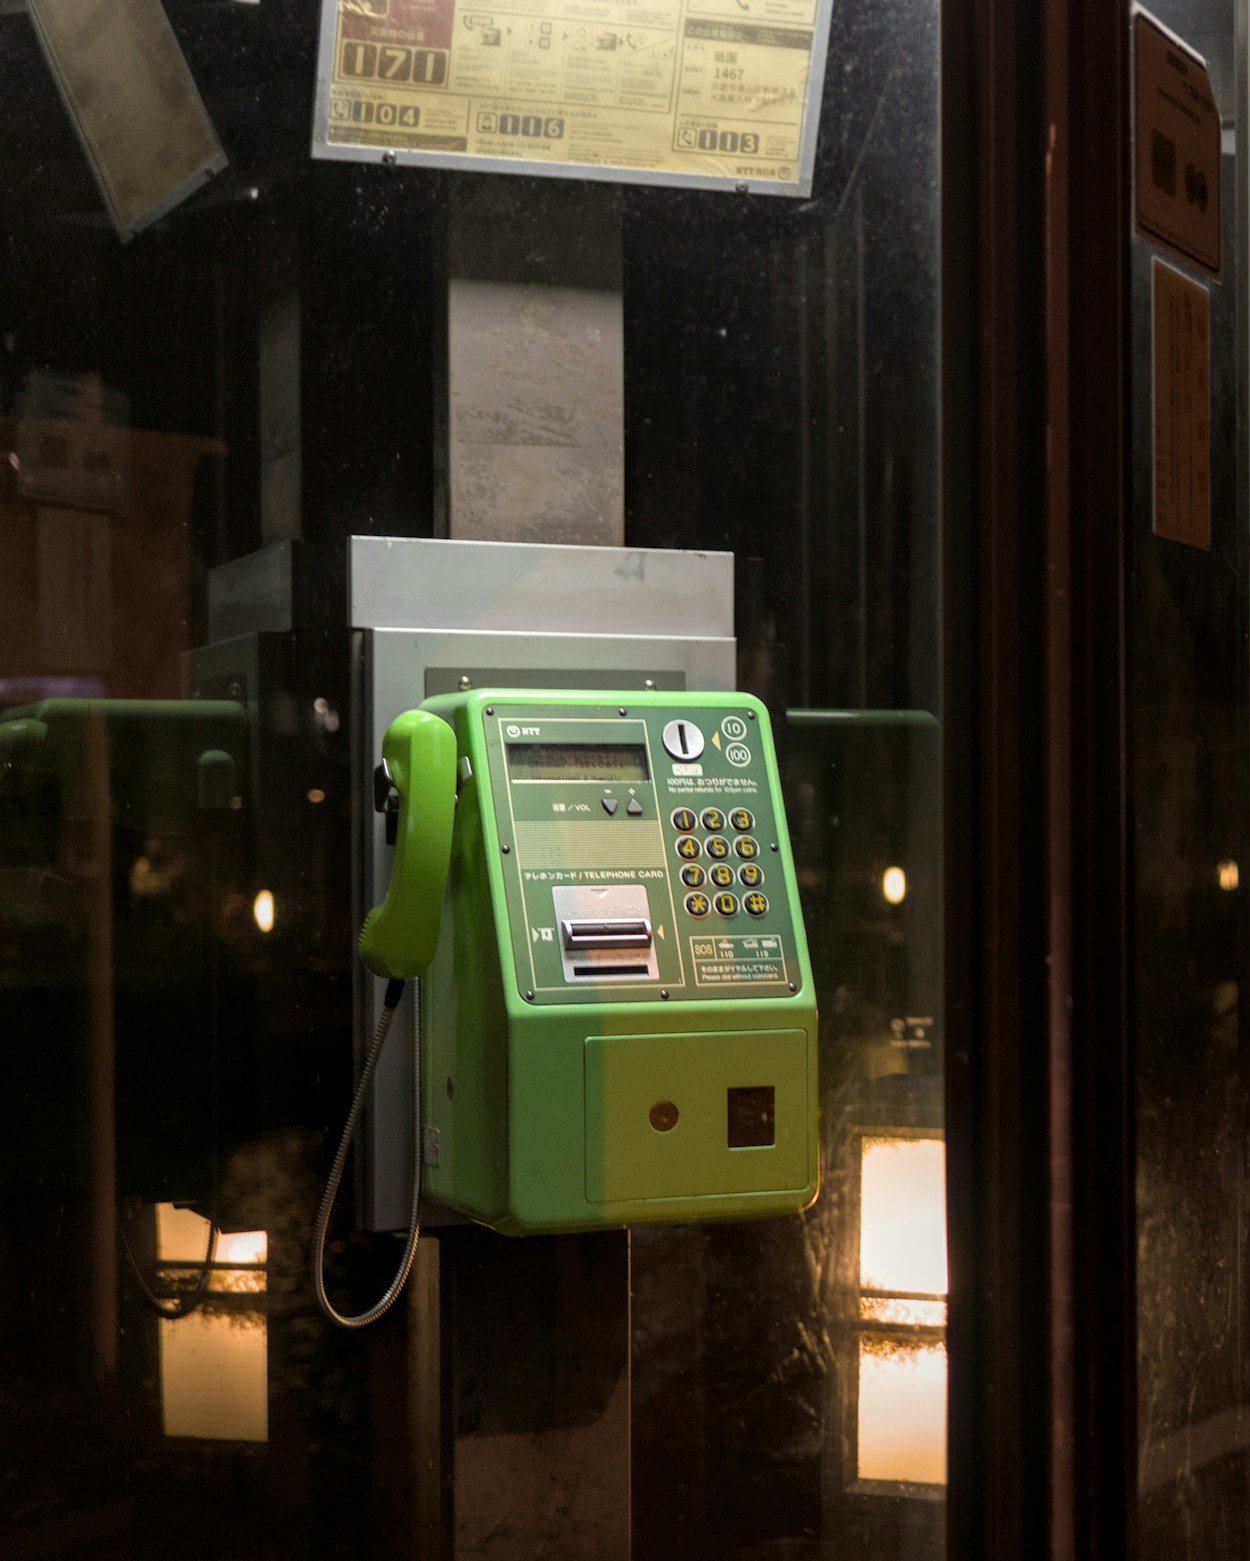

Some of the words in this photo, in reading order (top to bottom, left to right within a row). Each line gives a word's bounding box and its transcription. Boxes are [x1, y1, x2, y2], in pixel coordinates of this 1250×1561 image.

[355, 45, 435, 81] 171
[714, 67, 744, 80] 1467
[360, 102, 416, 125] 104
[506, 115, 559, 135] 116
[705, 130, 756, 151] 113
[521, 727, 540, 736] NTT
[727, 722, 741, 735] 10
[730, 749, 748, 761] 100
[682, 810, 690, 829] 1
[708, 809, 721, 829] 2
[737, 809, 750, 829] 3
[683, 838, 696, 856] 4
[713, 837, 726, 856] 5
[741, 837, 754, 856] 6
[583, 870, 636, 880] TELEPHONE
[638, 870, 664, 879] CARD
[689, 866, 699, 884] 7
[717, 865, 731, 884] 8
[745, 865, 758, 884] 9
[721, 893, 735, 913] 0
[694, 944, 714, 956] SOS
